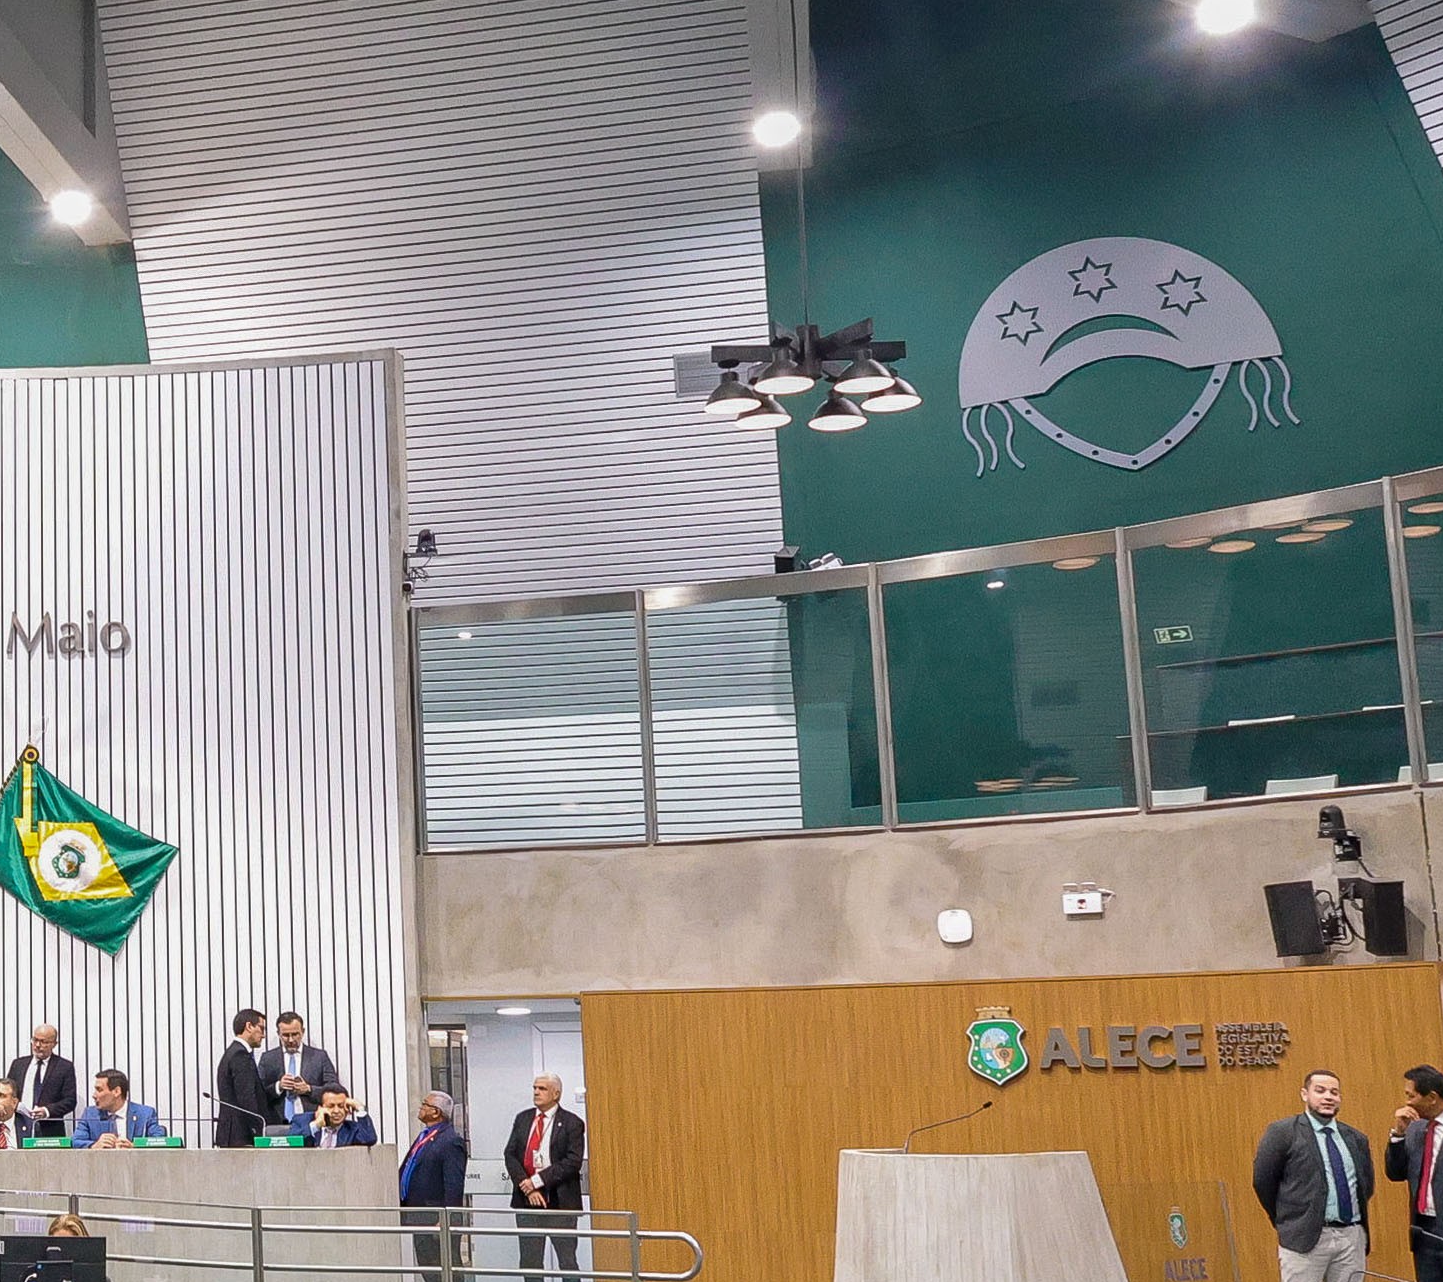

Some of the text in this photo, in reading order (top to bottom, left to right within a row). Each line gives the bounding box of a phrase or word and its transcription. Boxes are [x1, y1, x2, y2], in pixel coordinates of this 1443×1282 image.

[6, 609, 131, 657] Maio
[1040, 1023, 1207, 1069] ALECE
[1217, 1043, 1284, 1055] DO ESTADO
[1218, 1056, 1235, 1066] DO
